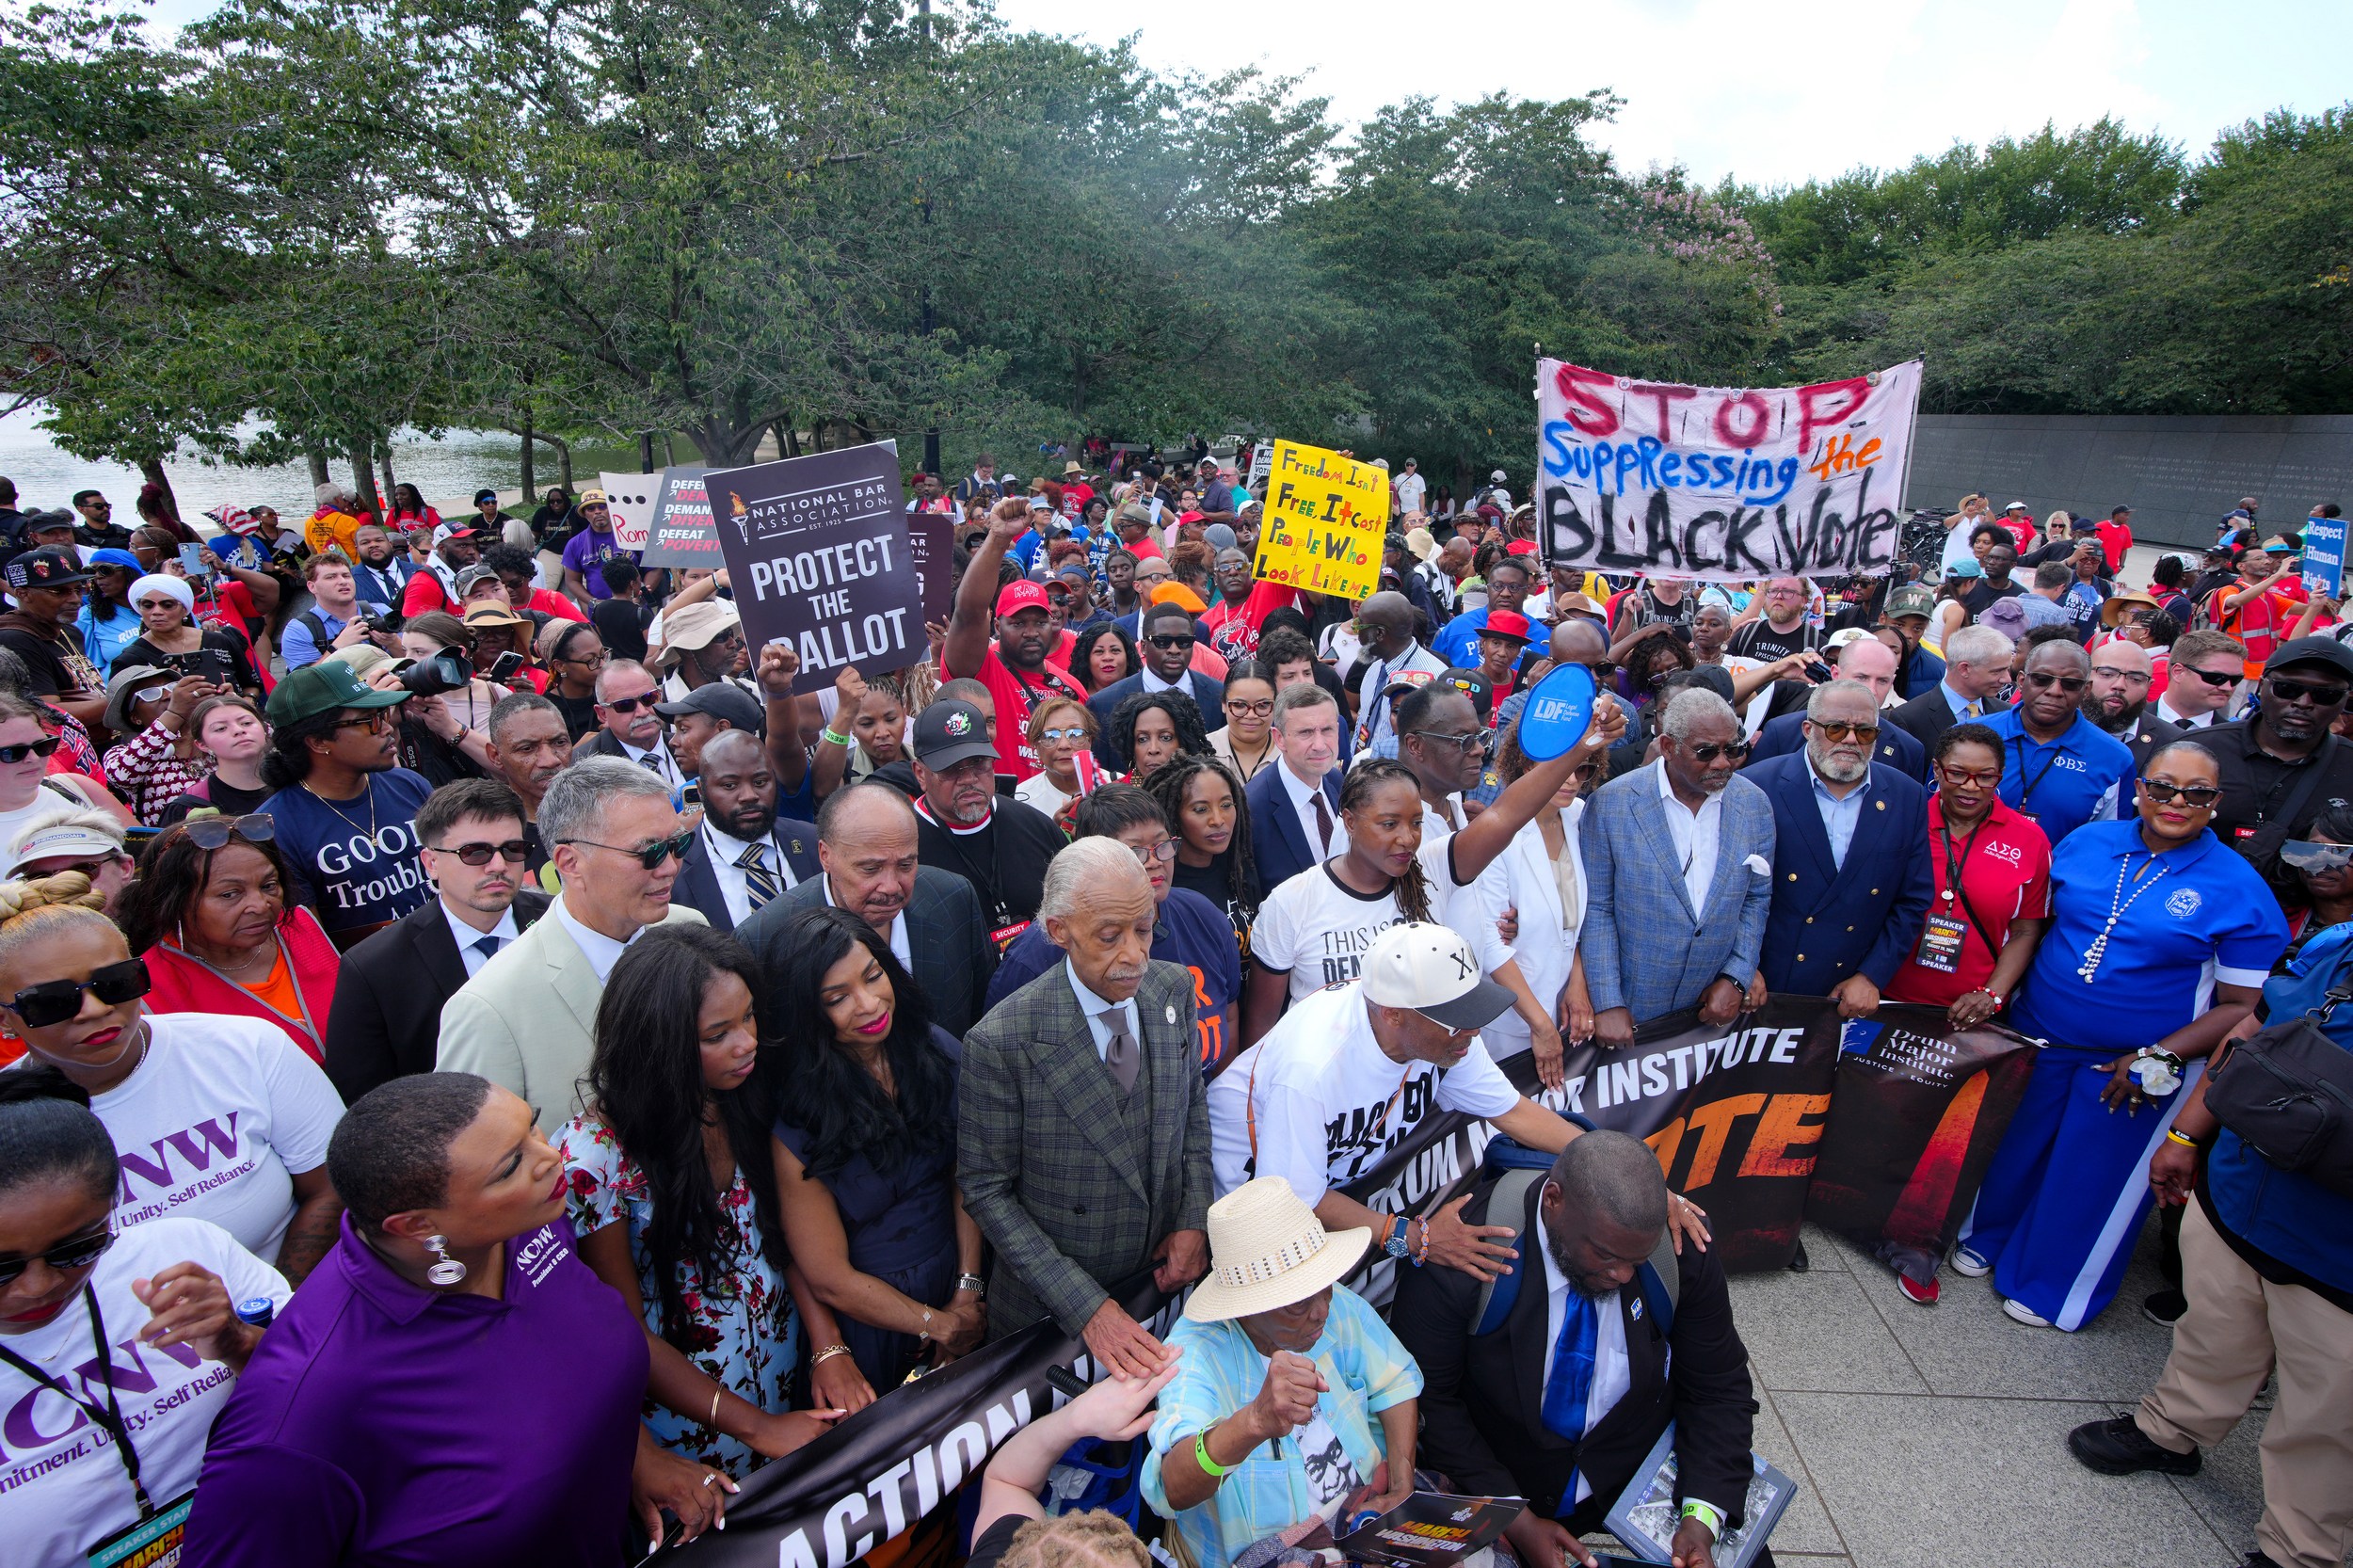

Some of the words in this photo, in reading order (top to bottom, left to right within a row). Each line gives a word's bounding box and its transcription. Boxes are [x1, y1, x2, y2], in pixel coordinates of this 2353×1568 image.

[1557, 364, 1871, 455] STOP
[1809, 434, 1881, 481] the
[1255, 466, 1269, 474] VOTI
[676, 490, 709, 501] DEM
[752, 492, 847, 519] NATIONAL
[855, 484, 886, 498] BAR
[664, 504, 712, 514] DEMAN
[613, 514, 649, 543] Rom
[669, 515, 714, 525] DIVER
[808, 522, 824, 531] EST.
[825, 519, 841, 527] 1925
[1545, 485, 1769, 575] BLACK
[2308, 521, 2344, 539] Respect
[658, 529, 705, 539] DEFEAT
[663, 539, 720, 552] POVERT
[2306, 545, 2339, 566] Human
[750, 534, 893, 601] PROTECT
[808, 588, 853, 620] THE
[1907, 594, 1923, 607] W
[118, 627, 140, 644] RUB
[1755, 651, 1784, 662] EPISCOPA
[1756, 642, 1789, 657] TRINITY
[1533, 699, 1566, 720] LDF
[407, 745, 415, 760] EOS
[34, 833, 83, 845] SHENANDOAH
[327, 856, 426, 908] Troubl
[996, 924, 1025, 938] SECURITY
[1929, 927, 1958, 937] MARCH
[1930, 918, 1964, 931] SPEAKER
[1321, 927, 1369, 954] THIS
[1925, 934, 1961, 945] WASHINGTON
[1922, 960, 1953, 972] SPEAKER
[1884, 1037, 1954, 1067] Major
[1892, 1029, 1958, 1055] Drum
[1853, 1056, 1895, 1073] JUSTICE
[1910, 1075, 1948, 1088] EQUITY
[1880, 1048, 1954, 1080] Institute
[118, 1112, 238, 1205] NW
[120, 1202, 168, 1227] Unity.
[168, 1184, 197, 1207] Self
[555, 1247, 569, 1261] CEO
[779, 1387, 1032, 1568] ACTION
[1596, 1027, 1804, 1110] INSTITUTE
[0, 1441, 90, 1494] itment.
[153, 1385, 191, 1416] Self
[190, 1366, 234, 1396] Relia
[1375, 1528, 1467, 1552] WASHINGTON
[1393, 1521, 1473, 1543] MARCH
[101, 1526, 157, 1563] SPEAKER
